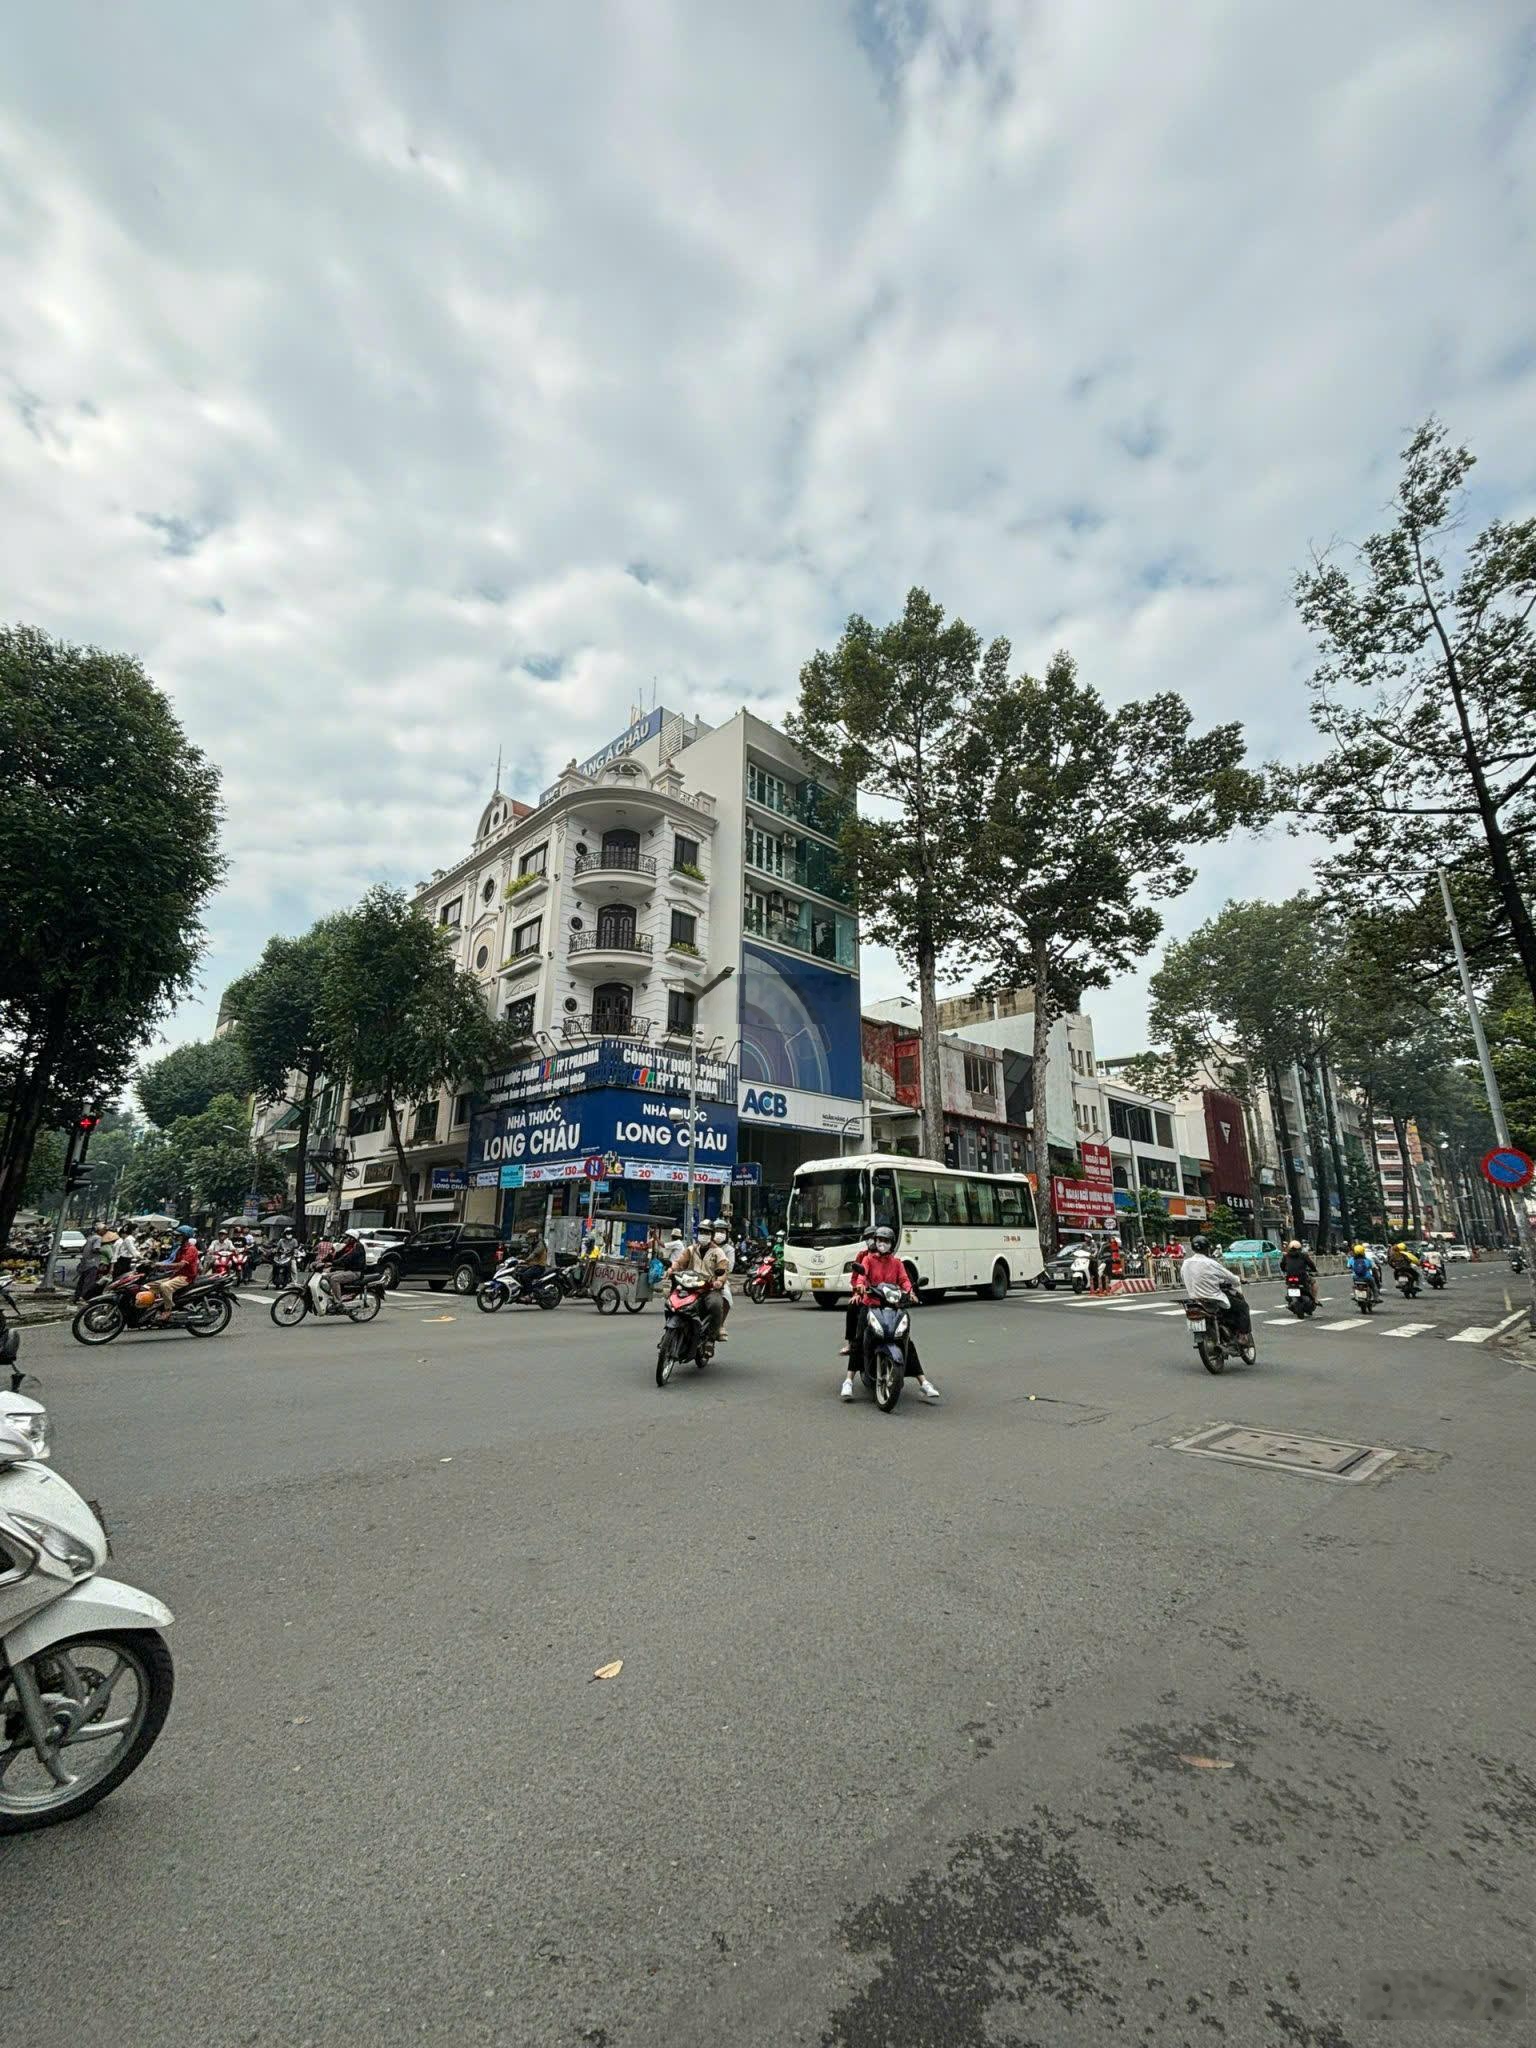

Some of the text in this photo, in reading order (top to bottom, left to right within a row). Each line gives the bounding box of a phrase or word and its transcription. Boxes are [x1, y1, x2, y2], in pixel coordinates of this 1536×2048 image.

[615, 721, 650, 757] CHÂU
[569, 1048, 599, 1070] PHARMA
[623, 1047, 653, 1068] CÔNG
[656, 1055, 669, 1070] TY
[700, 1062, 727, 1081] PHẨM
[656, 1071, 675, 1088] FPT
[507, 1100, 562, 1130] NHÀ THUỐC
[643, 1102, 668, 1118] NHÀ
[741, 1088, 788, 1118] ACB
[483, 1119, 581, 1162] LONG CHÂU
[616, 1121, 727, 1152] LONG CHÂU
